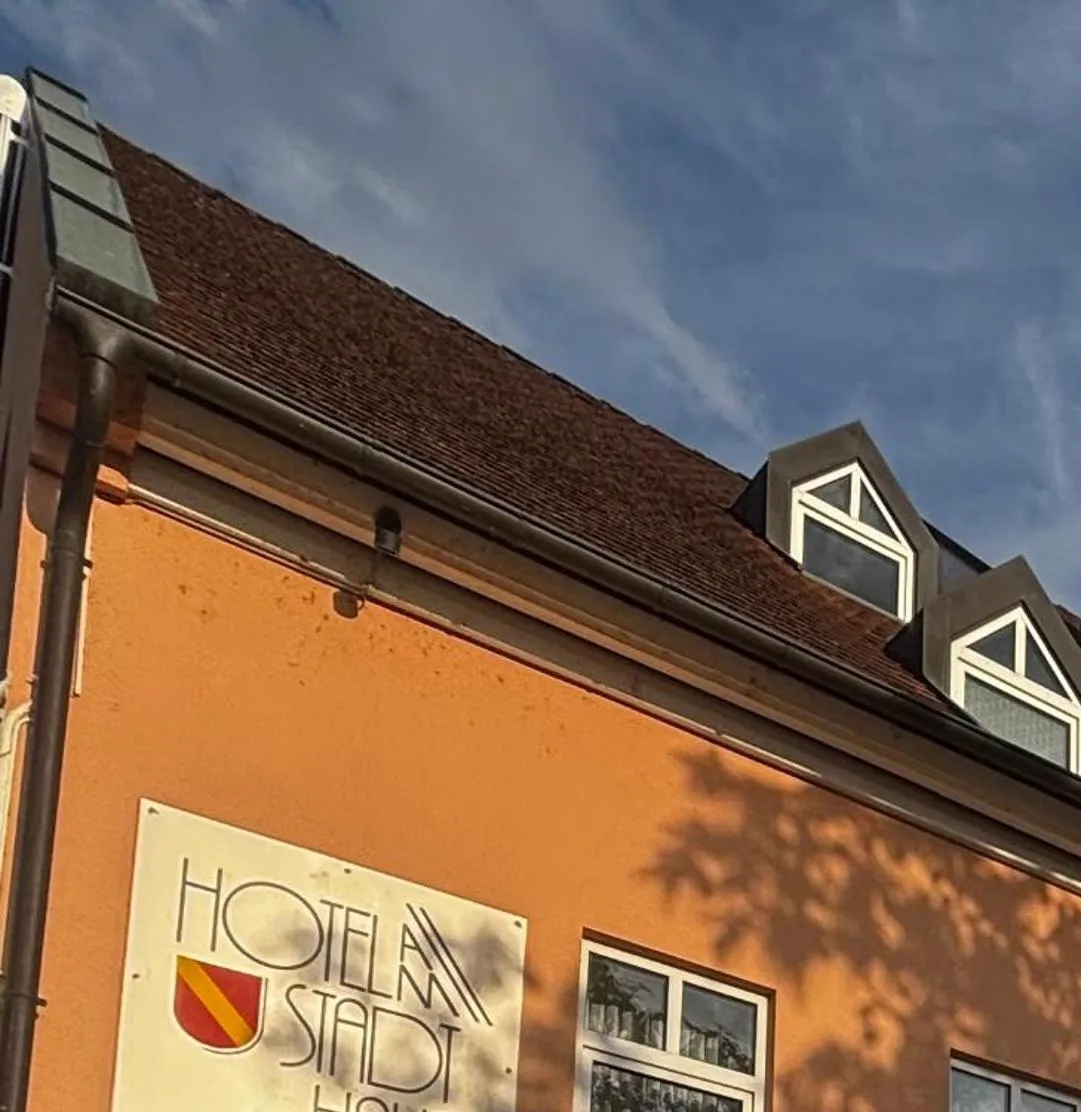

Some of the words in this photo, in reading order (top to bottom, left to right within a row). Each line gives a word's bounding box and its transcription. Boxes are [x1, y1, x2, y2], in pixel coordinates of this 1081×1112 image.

[175, 857, 393, 1000] HOTEL
[397, 922, 460, 1018] AM
[279, 983, 462, 1104] STADT
